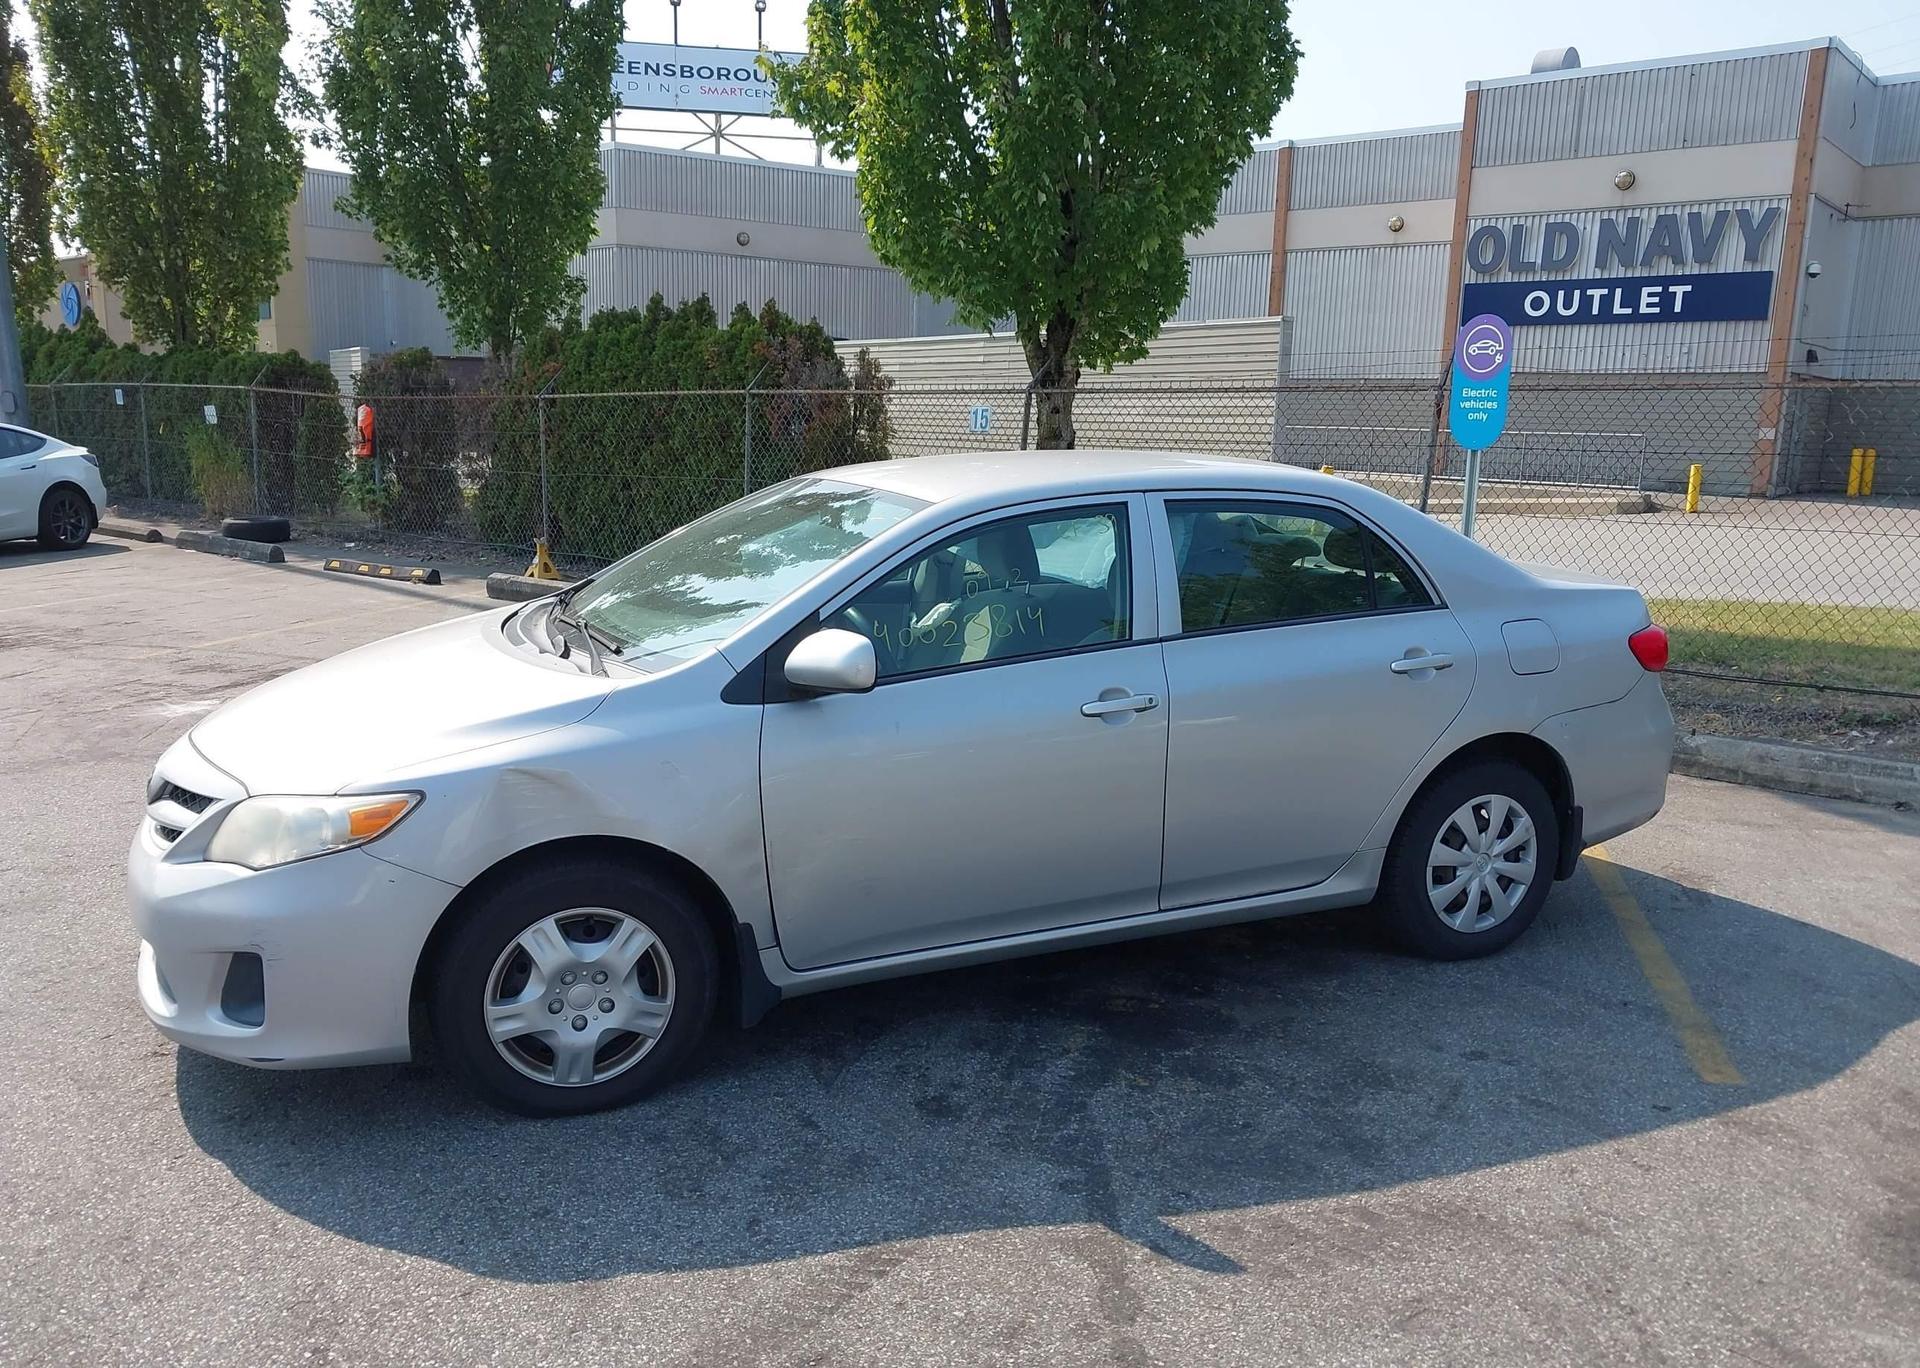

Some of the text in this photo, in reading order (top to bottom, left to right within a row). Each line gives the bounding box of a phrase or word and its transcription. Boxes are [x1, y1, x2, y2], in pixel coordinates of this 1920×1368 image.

[1467, 206, 1783, 274] OLD NAVY
[1524, 285, 1692, 317] OUTLET
[1463, 388, 1497, 397] Electric
[1460, 400, 1497, 408] vehicles
[973, 408, 988, 427] 15
[1467, 411, 1488, 422] only
